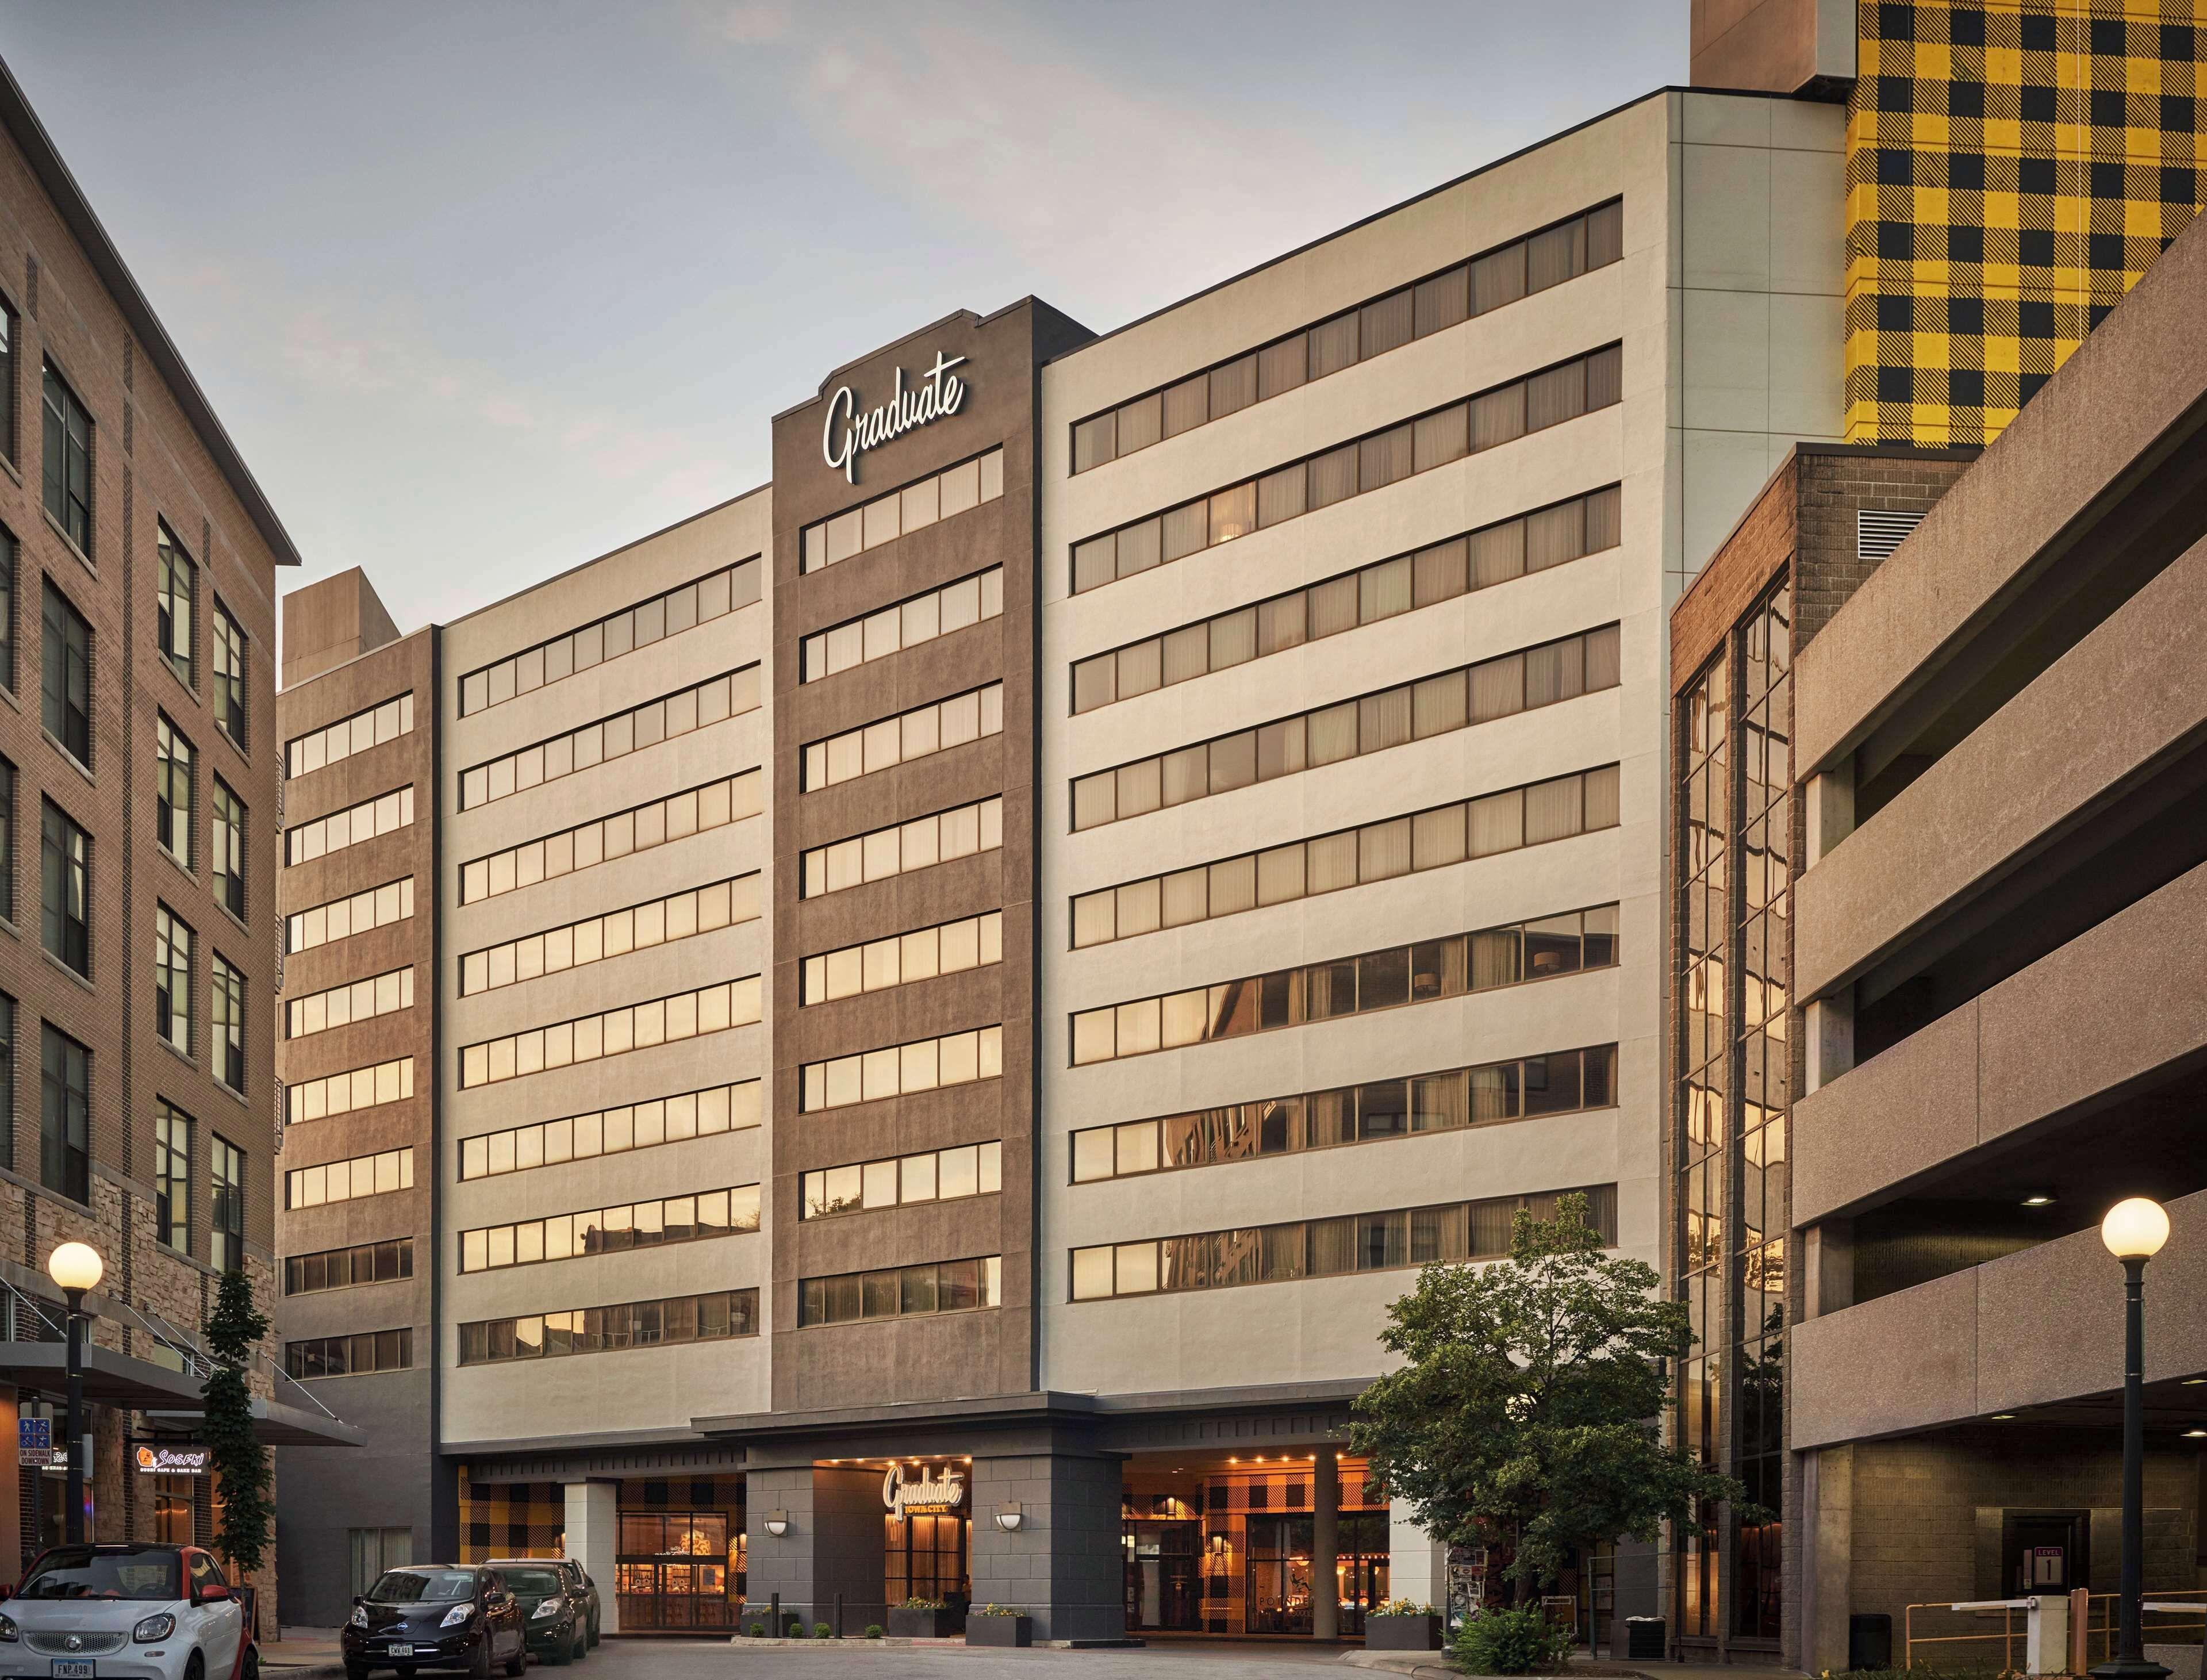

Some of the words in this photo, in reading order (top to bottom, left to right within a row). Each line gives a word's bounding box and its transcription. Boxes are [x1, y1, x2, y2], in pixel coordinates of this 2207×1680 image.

[823, 350, 965, 484] Graduate
[883, 1466, 964, 1521] Graduate
[904, 1505, 927, 1513] IOWA
[927, 1504, 947, 1513] CITY
[2046, 1559, 2051, 1580] 1
[58, 1664, 72, 1674] FNP
[74, 1665, 87, 1674] 499
